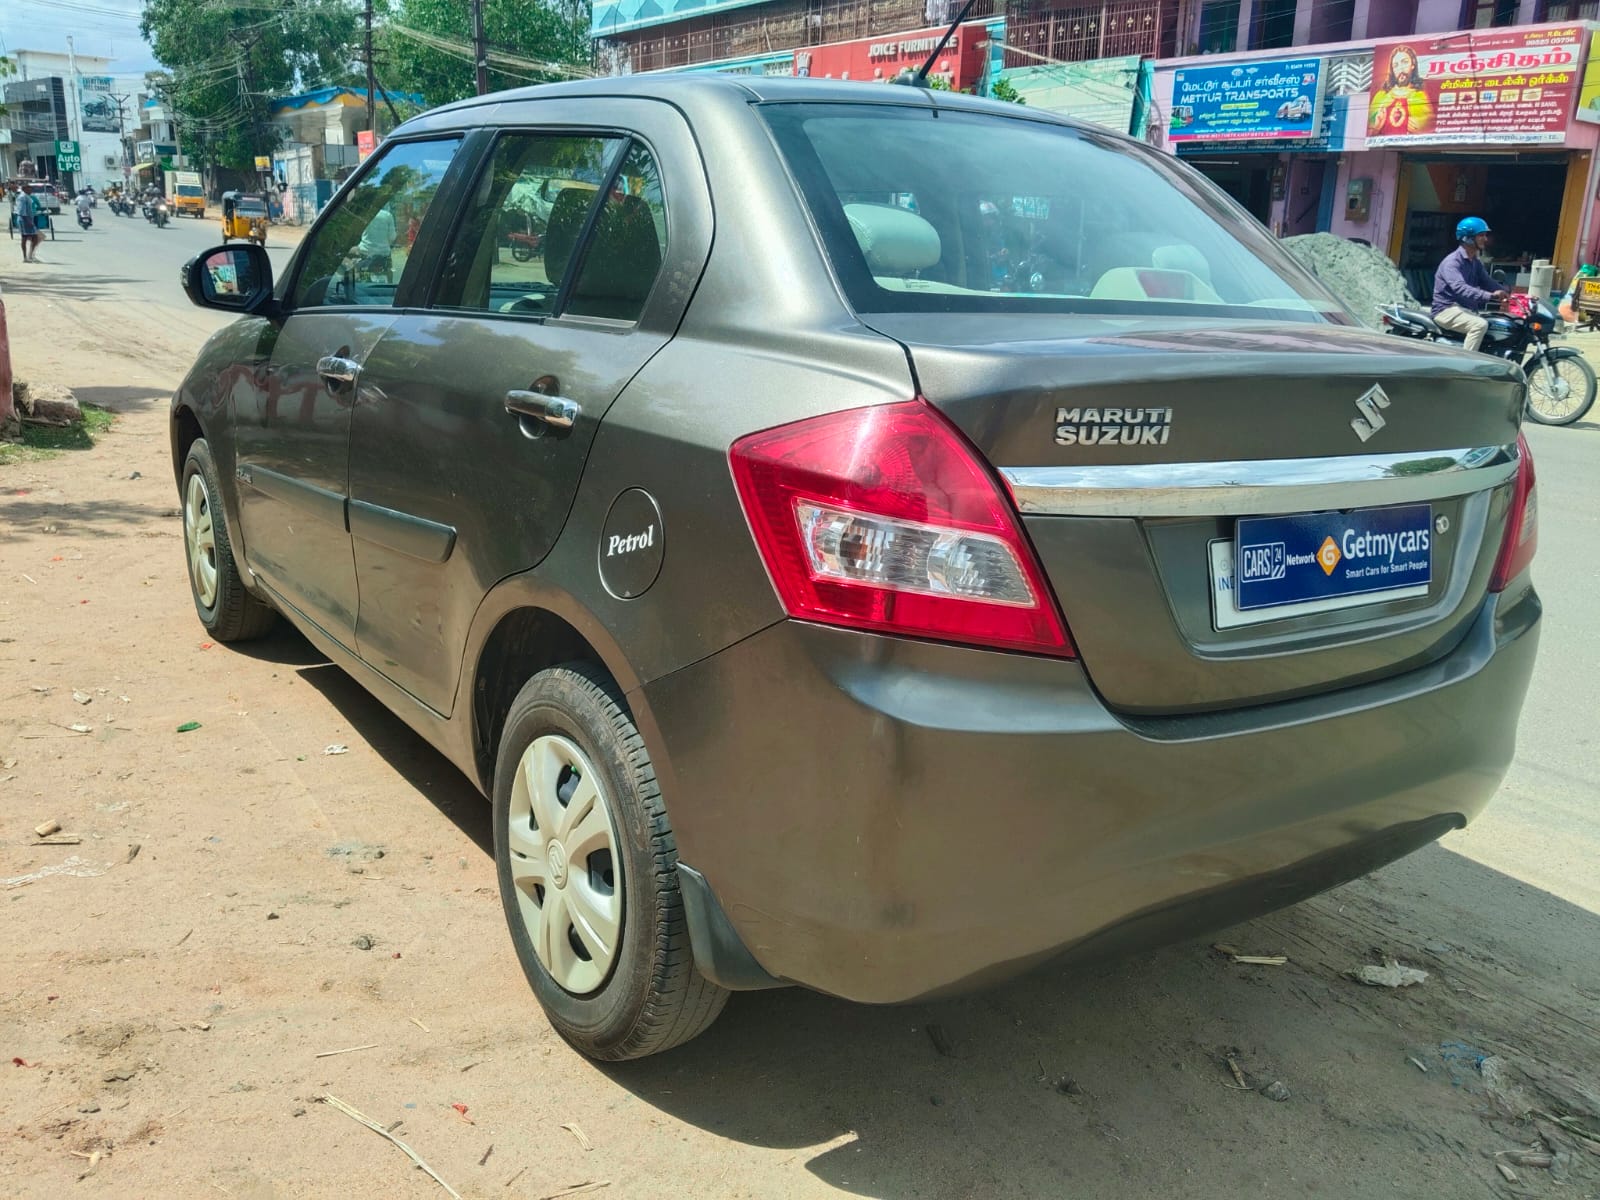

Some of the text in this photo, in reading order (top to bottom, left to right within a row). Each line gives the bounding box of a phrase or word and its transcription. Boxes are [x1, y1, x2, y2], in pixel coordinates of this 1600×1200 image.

[868, 42, 896, 57] JOICE
[1427, 47, 1572, 75] ரஞ்சிதம்
[1180, 87, 1299, 104] METTUR TRANSPORTS
[57, 153, 80, 162] Auto
[58, 162, 81, 171] LPG
[1055, 407, 1173, 424] MARUTI
[1054, 424, 1171, 446] SUZUKI
[606, 524, 654, 557] Petrol
[1342, 528, 1429, 563] Getmycars
[1244, 547, 1316, 578] CARS 24 Network
[1345, 560, 1428, 579] Smart Cars for Smart People
